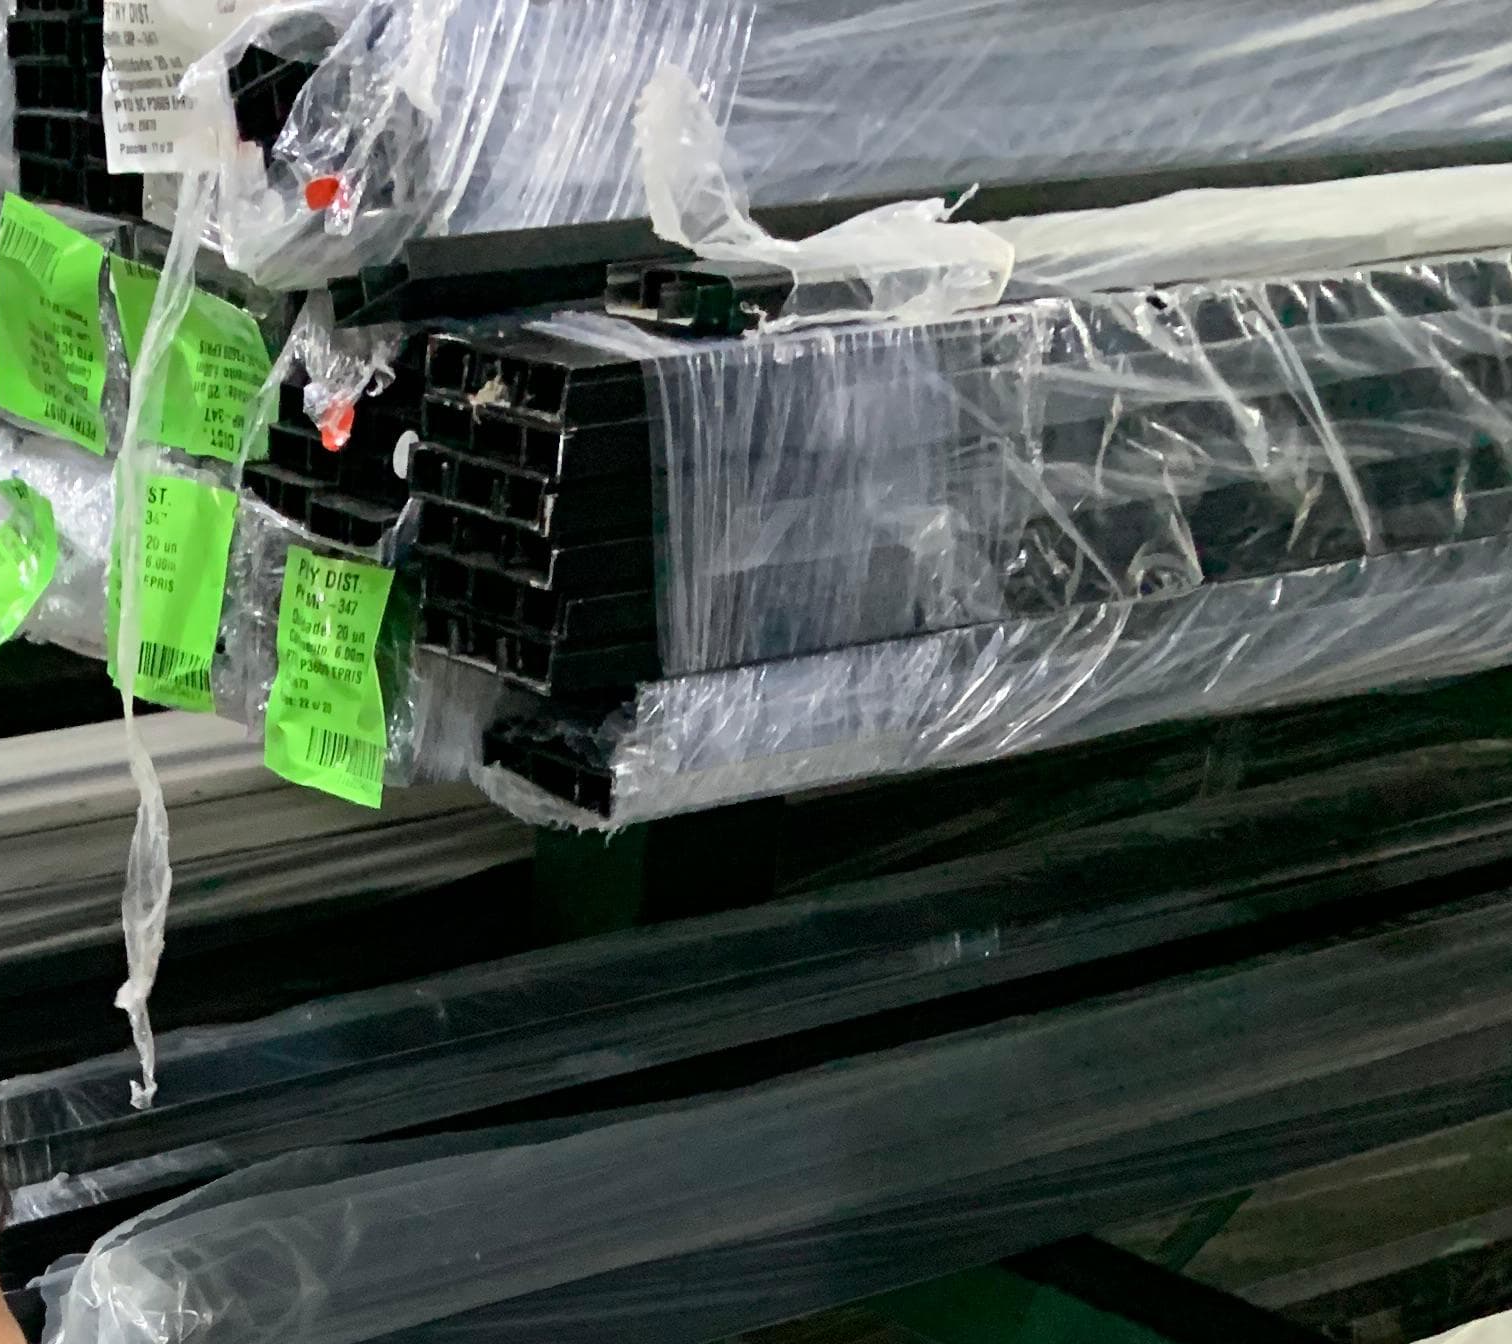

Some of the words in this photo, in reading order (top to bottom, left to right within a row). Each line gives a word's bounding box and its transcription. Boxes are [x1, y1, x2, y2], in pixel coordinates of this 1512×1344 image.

[146, 534, 160, 551] 20
[164, 539, 178, 554] un
[325, 570, 364, 595] DIST.
[336, 624, 349, 641] 20
[352, 631, 366, 645] un
